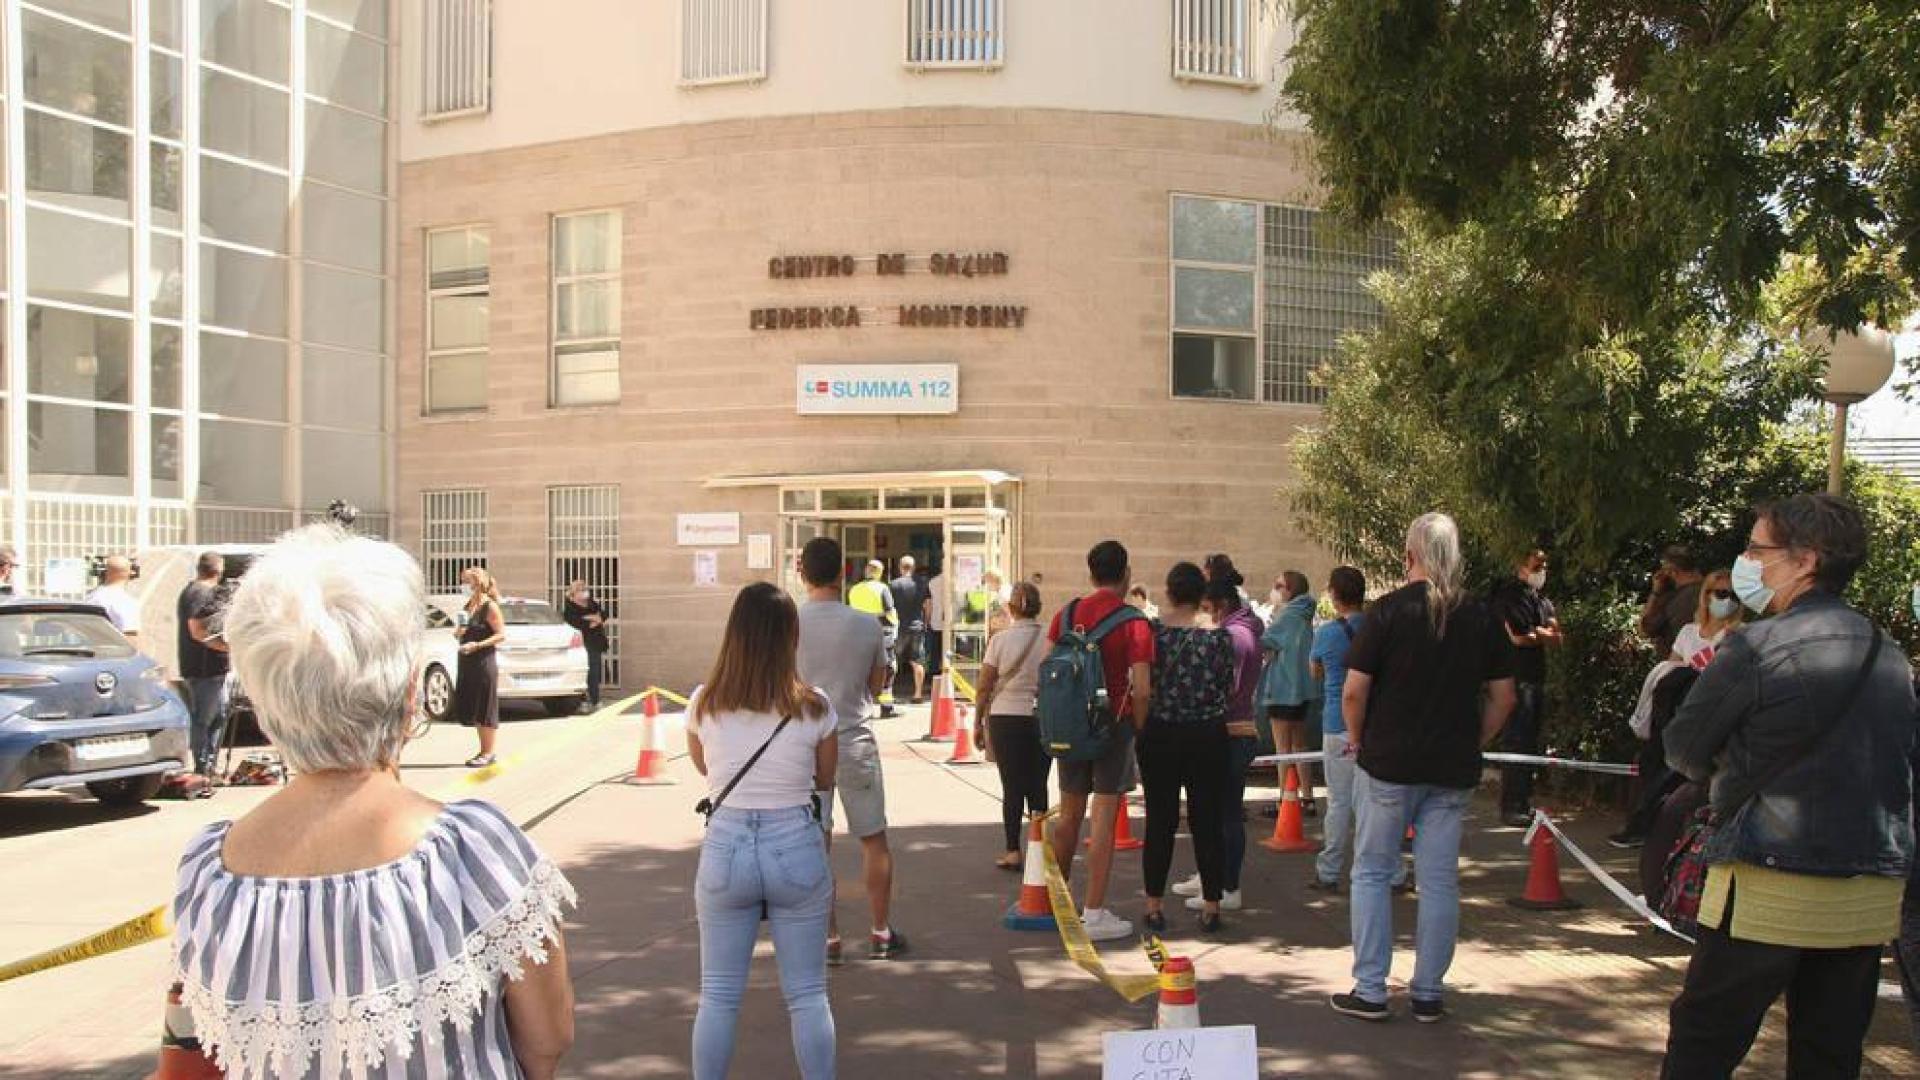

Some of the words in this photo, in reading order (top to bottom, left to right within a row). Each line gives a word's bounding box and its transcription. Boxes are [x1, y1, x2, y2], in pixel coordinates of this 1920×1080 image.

[769, 255, 855, 279] CENTRO
[876, 254, 905, 277] DE
[930, 252, 1009, 278] SALUD
[750, 306, 861, 330] FEDERICA
[899, 304, 1028, 328] MONTSENY
[832, 381, 913, 398] SUMMA
[919, 381, 951, 397] 112
[1142, 1034, 1196, 1064] CON
